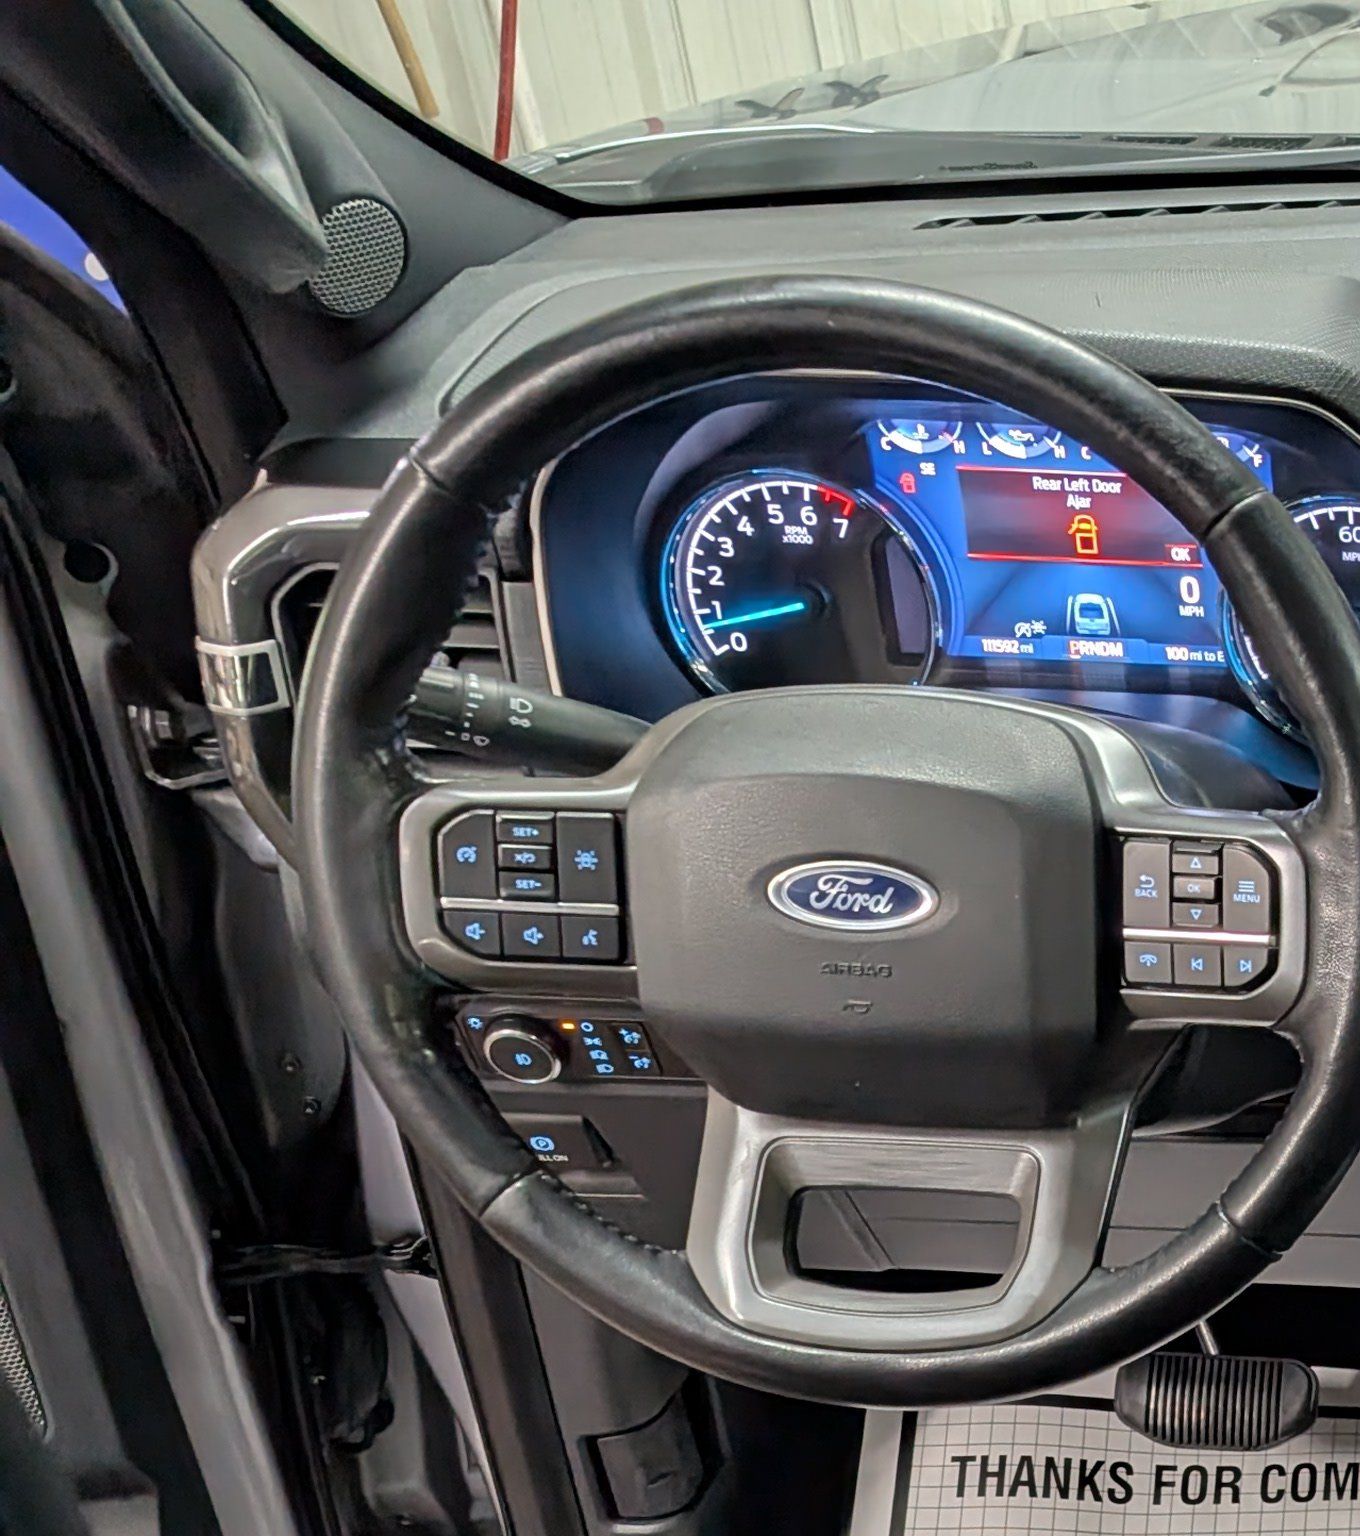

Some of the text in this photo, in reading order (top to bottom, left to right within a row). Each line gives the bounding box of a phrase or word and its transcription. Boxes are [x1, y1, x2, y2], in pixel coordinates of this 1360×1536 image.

[881, 437, 892, 451] C
[953, 440, 966, 454] H
[982, 442, 993, 455] L
[1054, 445, 1066, 459] H
[1032, 476, 1121, 494] Rear Left Door
[1067, 494, 1092, 509] Ajar
[767, 504, 784, 524] 5
[800, 506, 817, 525] 6
[737, 516, 754, 536] 4
[784, 526, 807, 535] RPM
[833, 518, 848, 538] 7
[717, 537, 734, 557] 3
[782, 534, 813, 545] x1000
[1170, 546, 1190, 562] OK
[707, 566, 725, 586] 2
[1180, 576, 1201, 604] 0
[711, 601, 722, 619] 1
[1179, 605, 1204, 617] MPH
[730, 632, 747, 651] 0
[1020, 643, 1034, 654] mi
[1069, 640, 1123, 658] PRNDM
[1165, 646, 1225, 662] 100 mi to E
[809, 874, 895, 914] Ford
[1134, 888, 1157, 898] BACK
[1187, 884, 1200, 893] OK
[1233, 893, 1260, 903] MENU
[820, 962, 893, 978] AIRBAG
[951, 1454, 1134, 1504] THANKS
[1152, 1464, 1242, 1505] FOR
